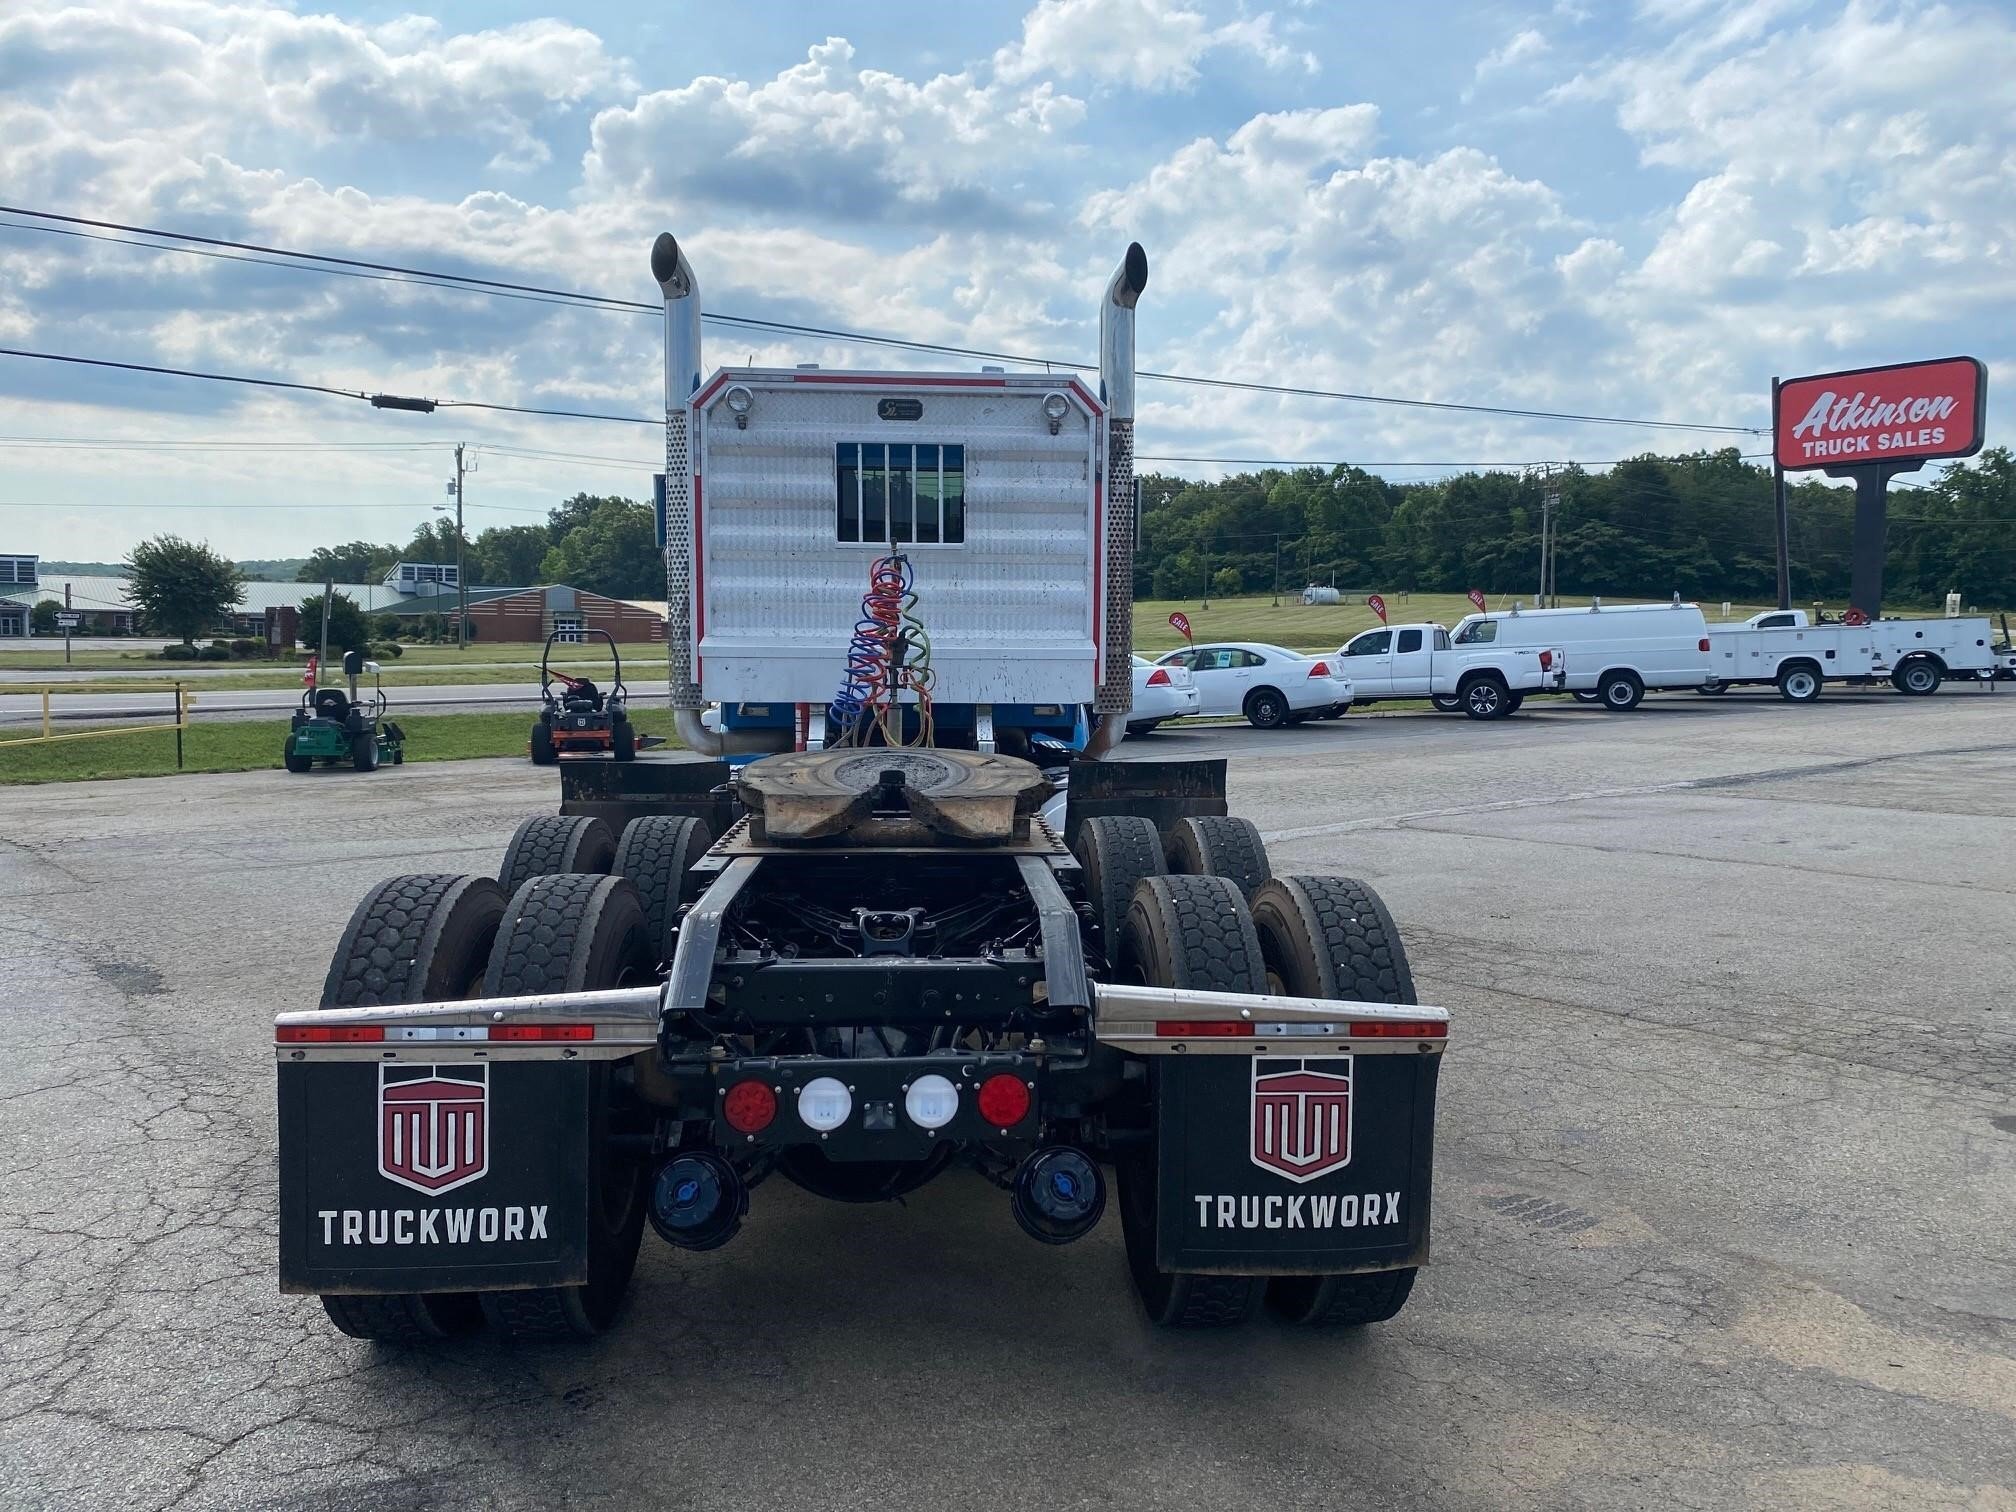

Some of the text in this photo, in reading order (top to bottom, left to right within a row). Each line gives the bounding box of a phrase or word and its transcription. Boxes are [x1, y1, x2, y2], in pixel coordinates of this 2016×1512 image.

[1792, 391, 1959, 439] Atkinson
[1802, 427, 1945, 458] TRUCK SALES
[1370, 599, 1384, 614] SALE
[1172, 617, 1188, 631] SALE
[318, 1205, 548, 1245] TRUCKWORX
[1194, 1191, 1401, 1229] TRUCKWORX
